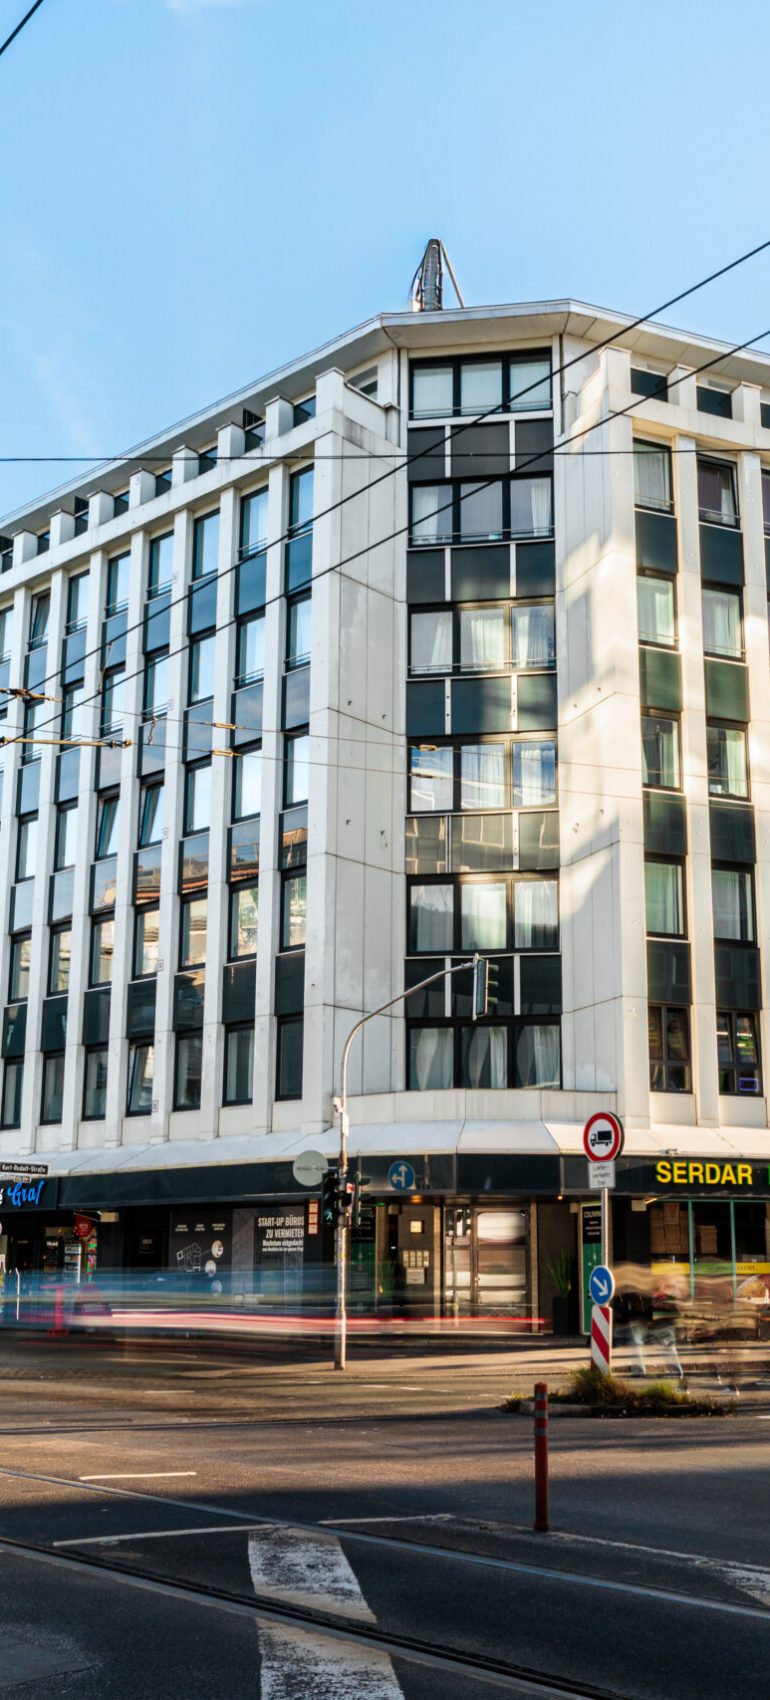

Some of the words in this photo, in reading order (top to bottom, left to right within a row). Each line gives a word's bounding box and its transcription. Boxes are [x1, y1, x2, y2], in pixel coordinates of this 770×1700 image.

[656, 1160, 753, 1185] SERDAR
[258, 1217, 285, 1227] START-UP
[285, 1215, 304, 1226] BÜROS
[266, 1229, 273, 1238] ZU
[274, 1228, 304, 1238] VERMIETEN
